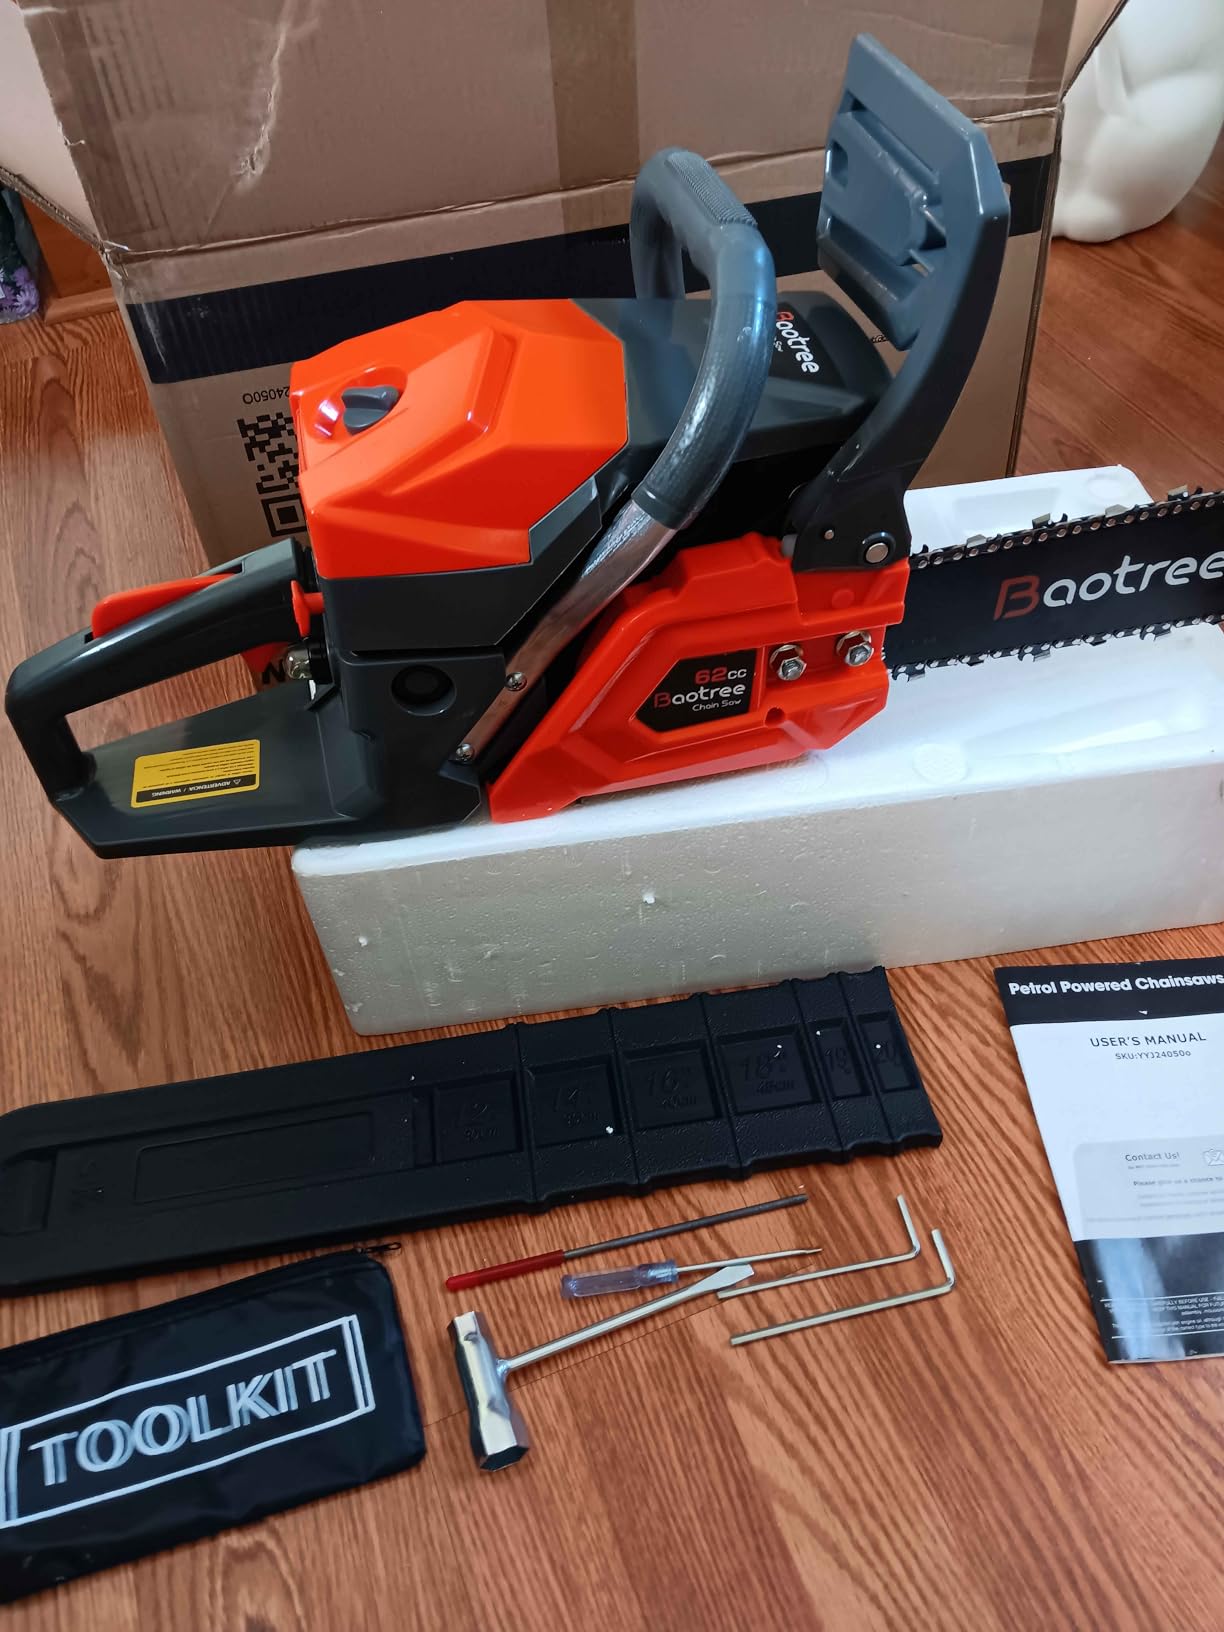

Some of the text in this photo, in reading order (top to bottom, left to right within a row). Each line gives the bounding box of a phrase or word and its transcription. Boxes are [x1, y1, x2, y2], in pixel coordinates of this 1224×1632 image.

[992, 551, 1224, 621] Baotree
[695, 667, 747, 684] 62cc
[654, 684, 746, 708] Baotree
[692, 700, 742, 711] Chain Saw
[1008, 974, 1224, 995] Petrol Powered Chainsaws
[1090, 1031, 1207, 1047] USER'S MANUAL
[1125, 1151, 1180, 1161] Contact Us!
[28, 1349, 337, 1486] TOOLKIT
